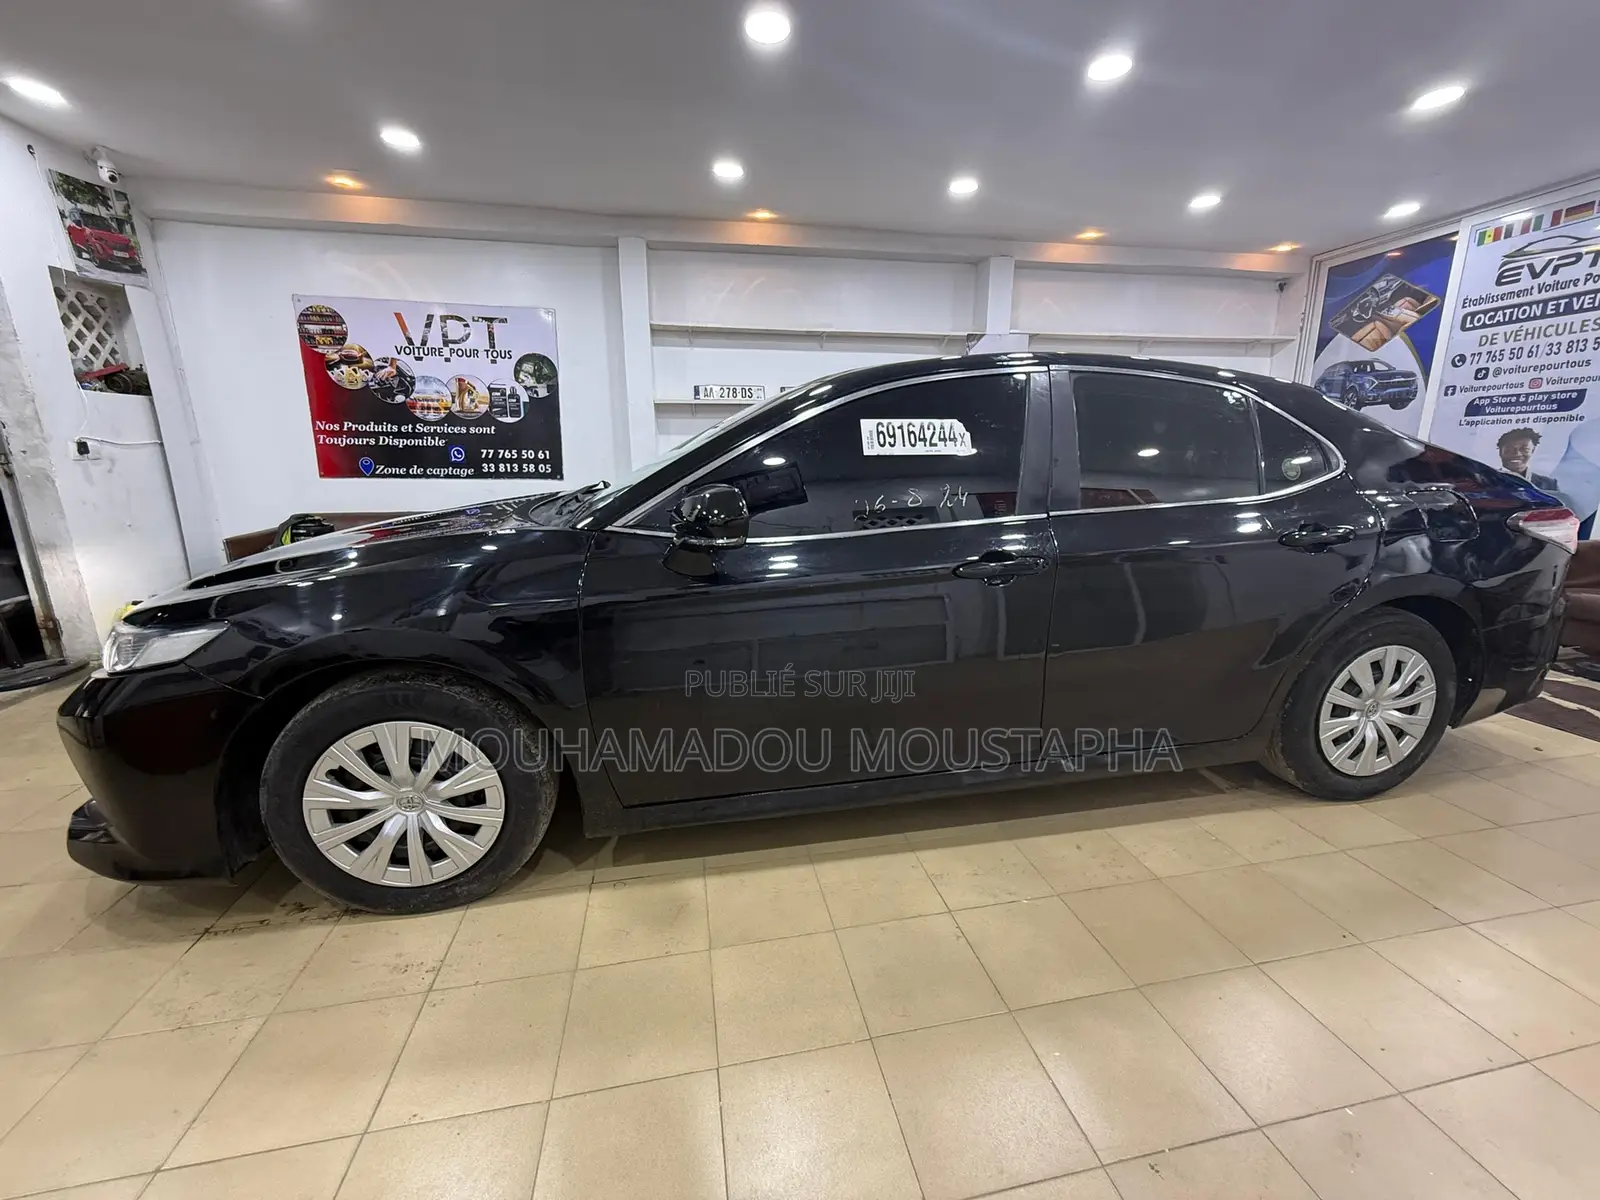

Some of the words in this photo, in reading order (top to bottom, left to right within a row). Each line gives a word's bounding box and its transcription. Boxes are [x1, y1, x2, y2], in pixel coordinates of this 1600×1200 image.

[1461, 284, 1534, 309] Établissement
[1537, 278, 1580, 294] Voiture
[1465, 303, 1543, 328] LOCATION
[1546, 299, 1569, 315] ET
[393, 312, 508, 364] VPT
[1478, 332, 1499, 347] DE
[1504, 316, 1600, 344] VÉHICULES
[394, 345, 445, 358] VOITURE
[449, 347, 480, 359] POUR
[485, 349, 513, 360] TOUS
[1469, 352, 1482, 365] 77
[1486, 349, 1505, 363] 765
[1508, 346, 1524, 360] 50
[1566, 338, 1588, 354] 813
[1492, 359, 1592, 378] @voiturepourtous
[1459, 381, 1524, 394] Voiturepourtous
[1473, 397, 1490, 406] App
[1492, 395, 1517, 404] Store
[1519, 394, 1527, 402] &
[1528, 393, 1548, 403] play
[1551, 391, 1578, 399] store
[1485, 403, 1558, 414] Voiturepourtous
[1532, 413, 1585, 424] disponible
[315, 420, 340, 431] Nos
[343, 421, 398, 433] Produits
[401, 424, 413, 433] et
[415, 423, 467, 434] Services
[469, 425, 496, 435] sont
[317, 434, 375, 447] Toujours
[378, 435, 446, 448] Disponible
[480, 449, 495, 459] 77
[498, 449, 518, 459] 765
[520, 449, 535, 459] 50
[537, 449, 550, 459] 61
[375, 464, 406, 476] Zone
[409, 465, 422, 476] de
[425, 466, 475, 477] captage
[482, 463, 496, 473] 33
[498, 463, 519, 473] 813
[521, 463, 535, 473] 58
[537, 463, 552, 474] 05
